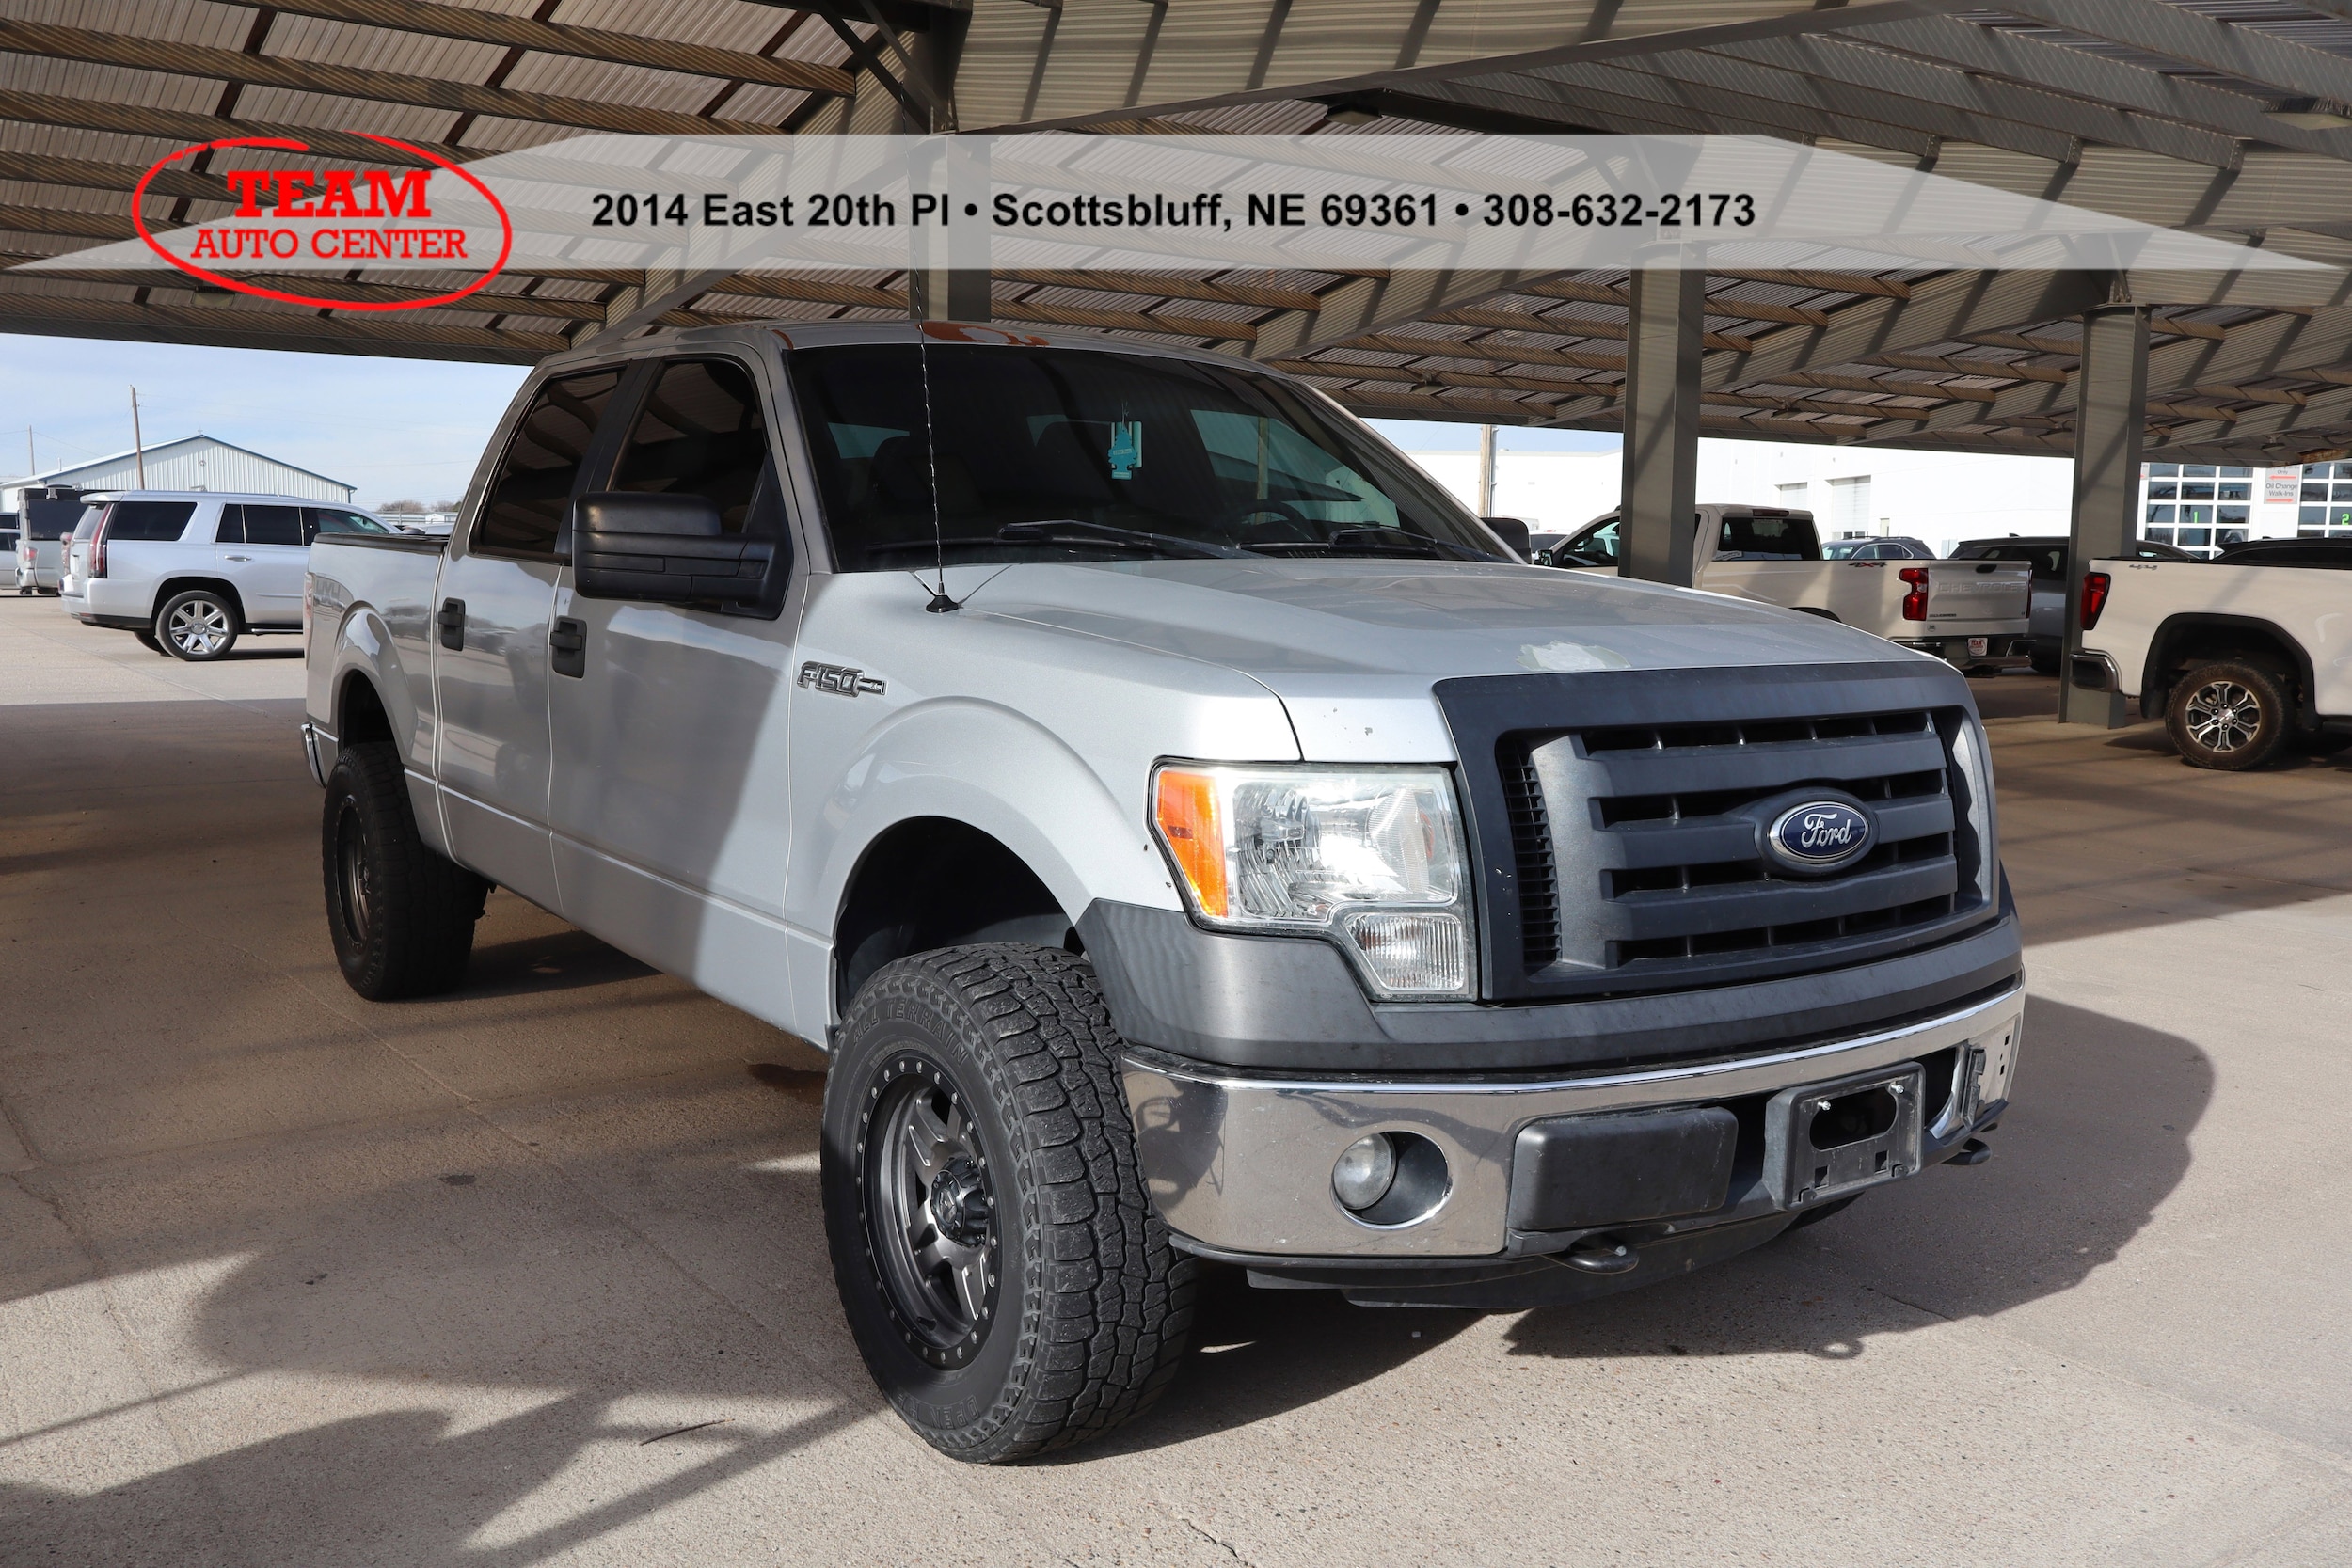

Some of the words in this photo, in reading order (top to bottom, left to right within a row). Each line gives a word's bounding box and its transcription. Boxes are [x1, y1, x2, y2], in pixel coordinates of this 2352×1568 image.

[2342, 513, 2350, 526] 2
[1801, 813, 1851, 848] Ford
[853, 1006, 881, 1046] ALL
[886, 998, 969, 1067] TERRAIN
[930, 1394, 980, 1430] OPEN
